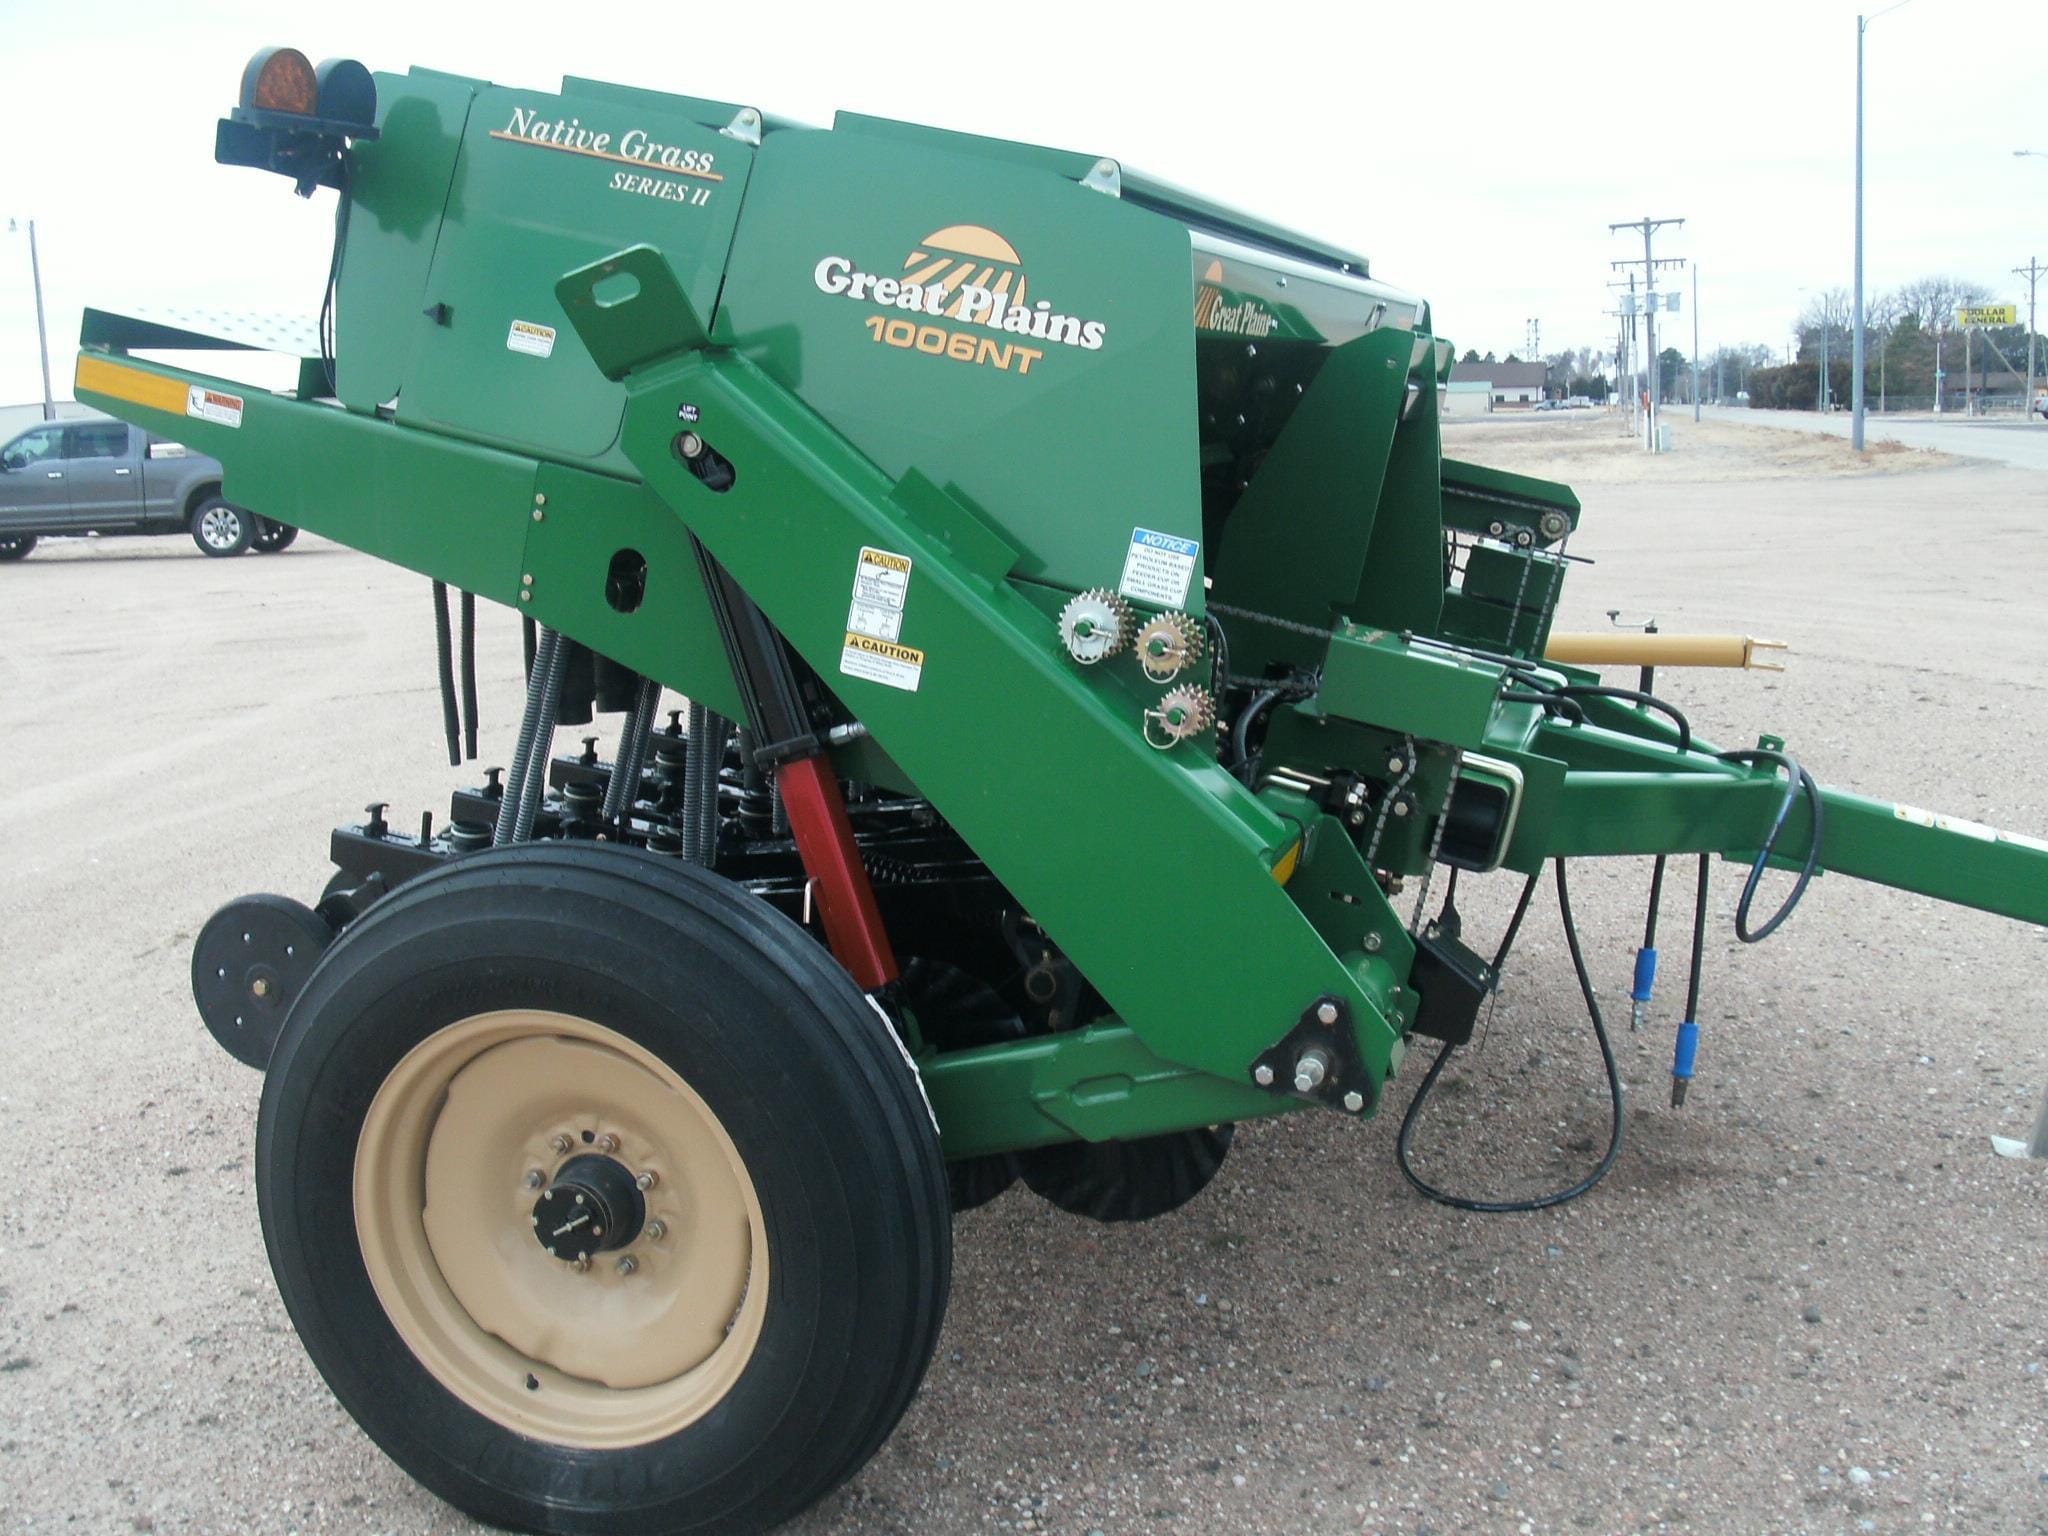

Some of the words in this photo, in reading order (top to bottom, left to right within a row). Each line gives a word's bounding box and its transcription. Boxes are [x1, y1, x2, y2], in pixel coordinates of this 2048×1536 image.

[503, 107, 611, 153] Native
[619, 129, 715, 174] Grass
[609, 171, 689, 203] SERIES
[690, 187, 713, 207] II
[814, 256, 949, 316] Great
[954, 283, 1106, 350] Plains
[1209, 295, 1242, 334] Great
[1239, 301, 1272, 338] Plains
[1968, 308, 2006, 316] DOLLAR
[865, 315, 1043, 375] 1006NT
[1142, 534, 1192, 553] NOTICE
[874, 554, 907, 573] CAUTION
[861, 639, 920, 663] CAUTION
